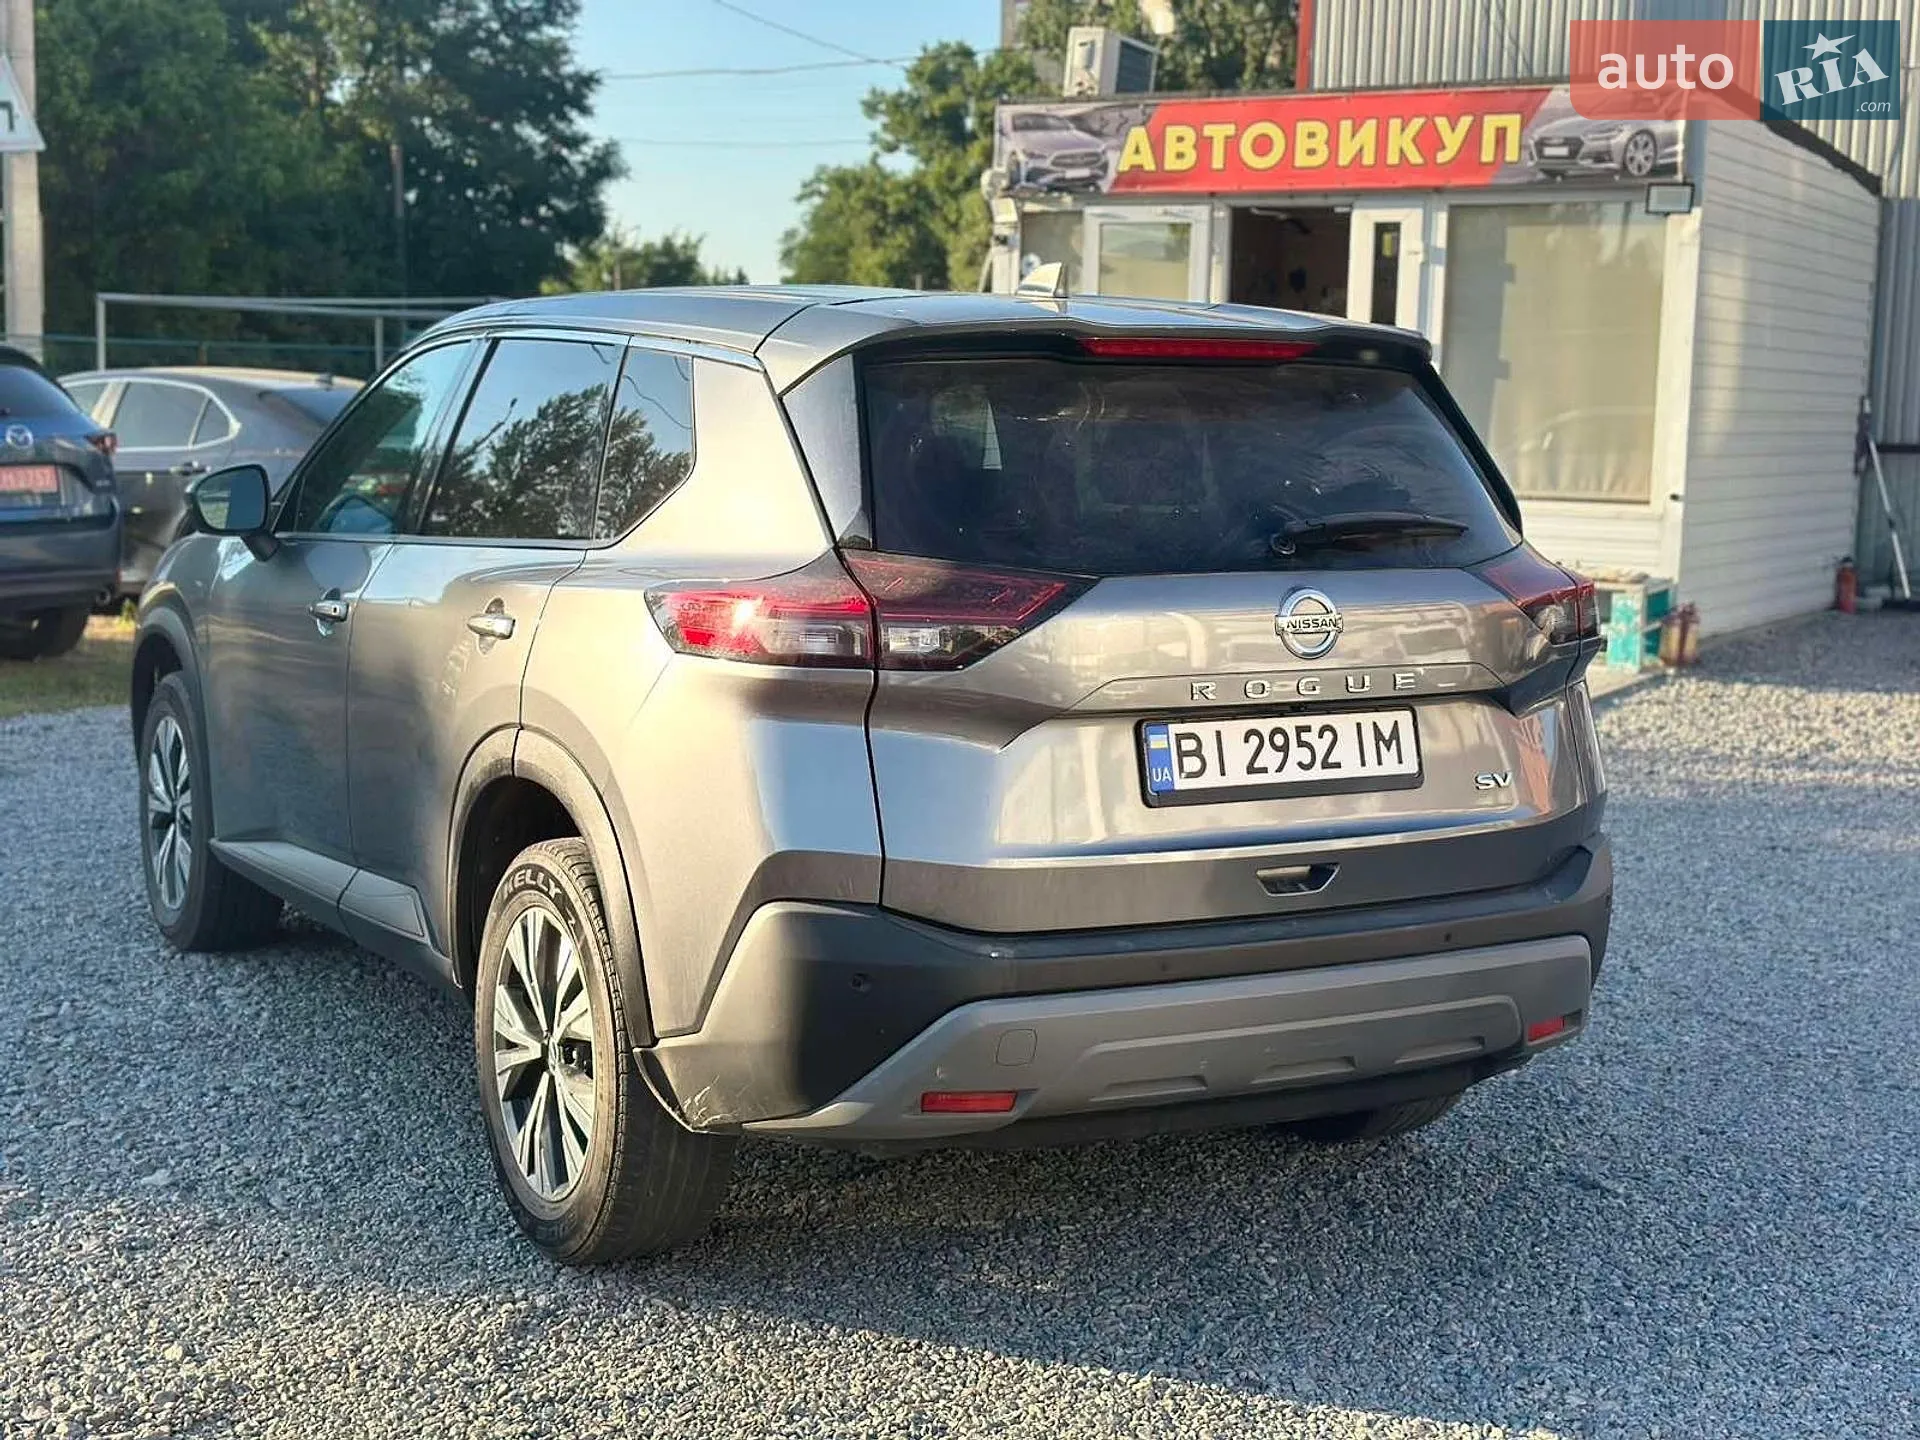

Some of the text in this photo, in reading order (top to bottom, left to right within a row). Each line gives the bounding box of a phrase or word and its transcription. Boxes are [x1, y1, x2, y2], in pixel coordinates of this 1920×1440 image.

[1116, 113, 1522, 173] АВТОВИКУП
[1286, 617, 1338, 630] NISSAN
[1191, 672, 1417, 701] ROGUE
[1174, 719, 1404, 779] BI 2952 IM
[1152, 767, 1172, 783] UA
[1474, 771, 1513, 790] SV
